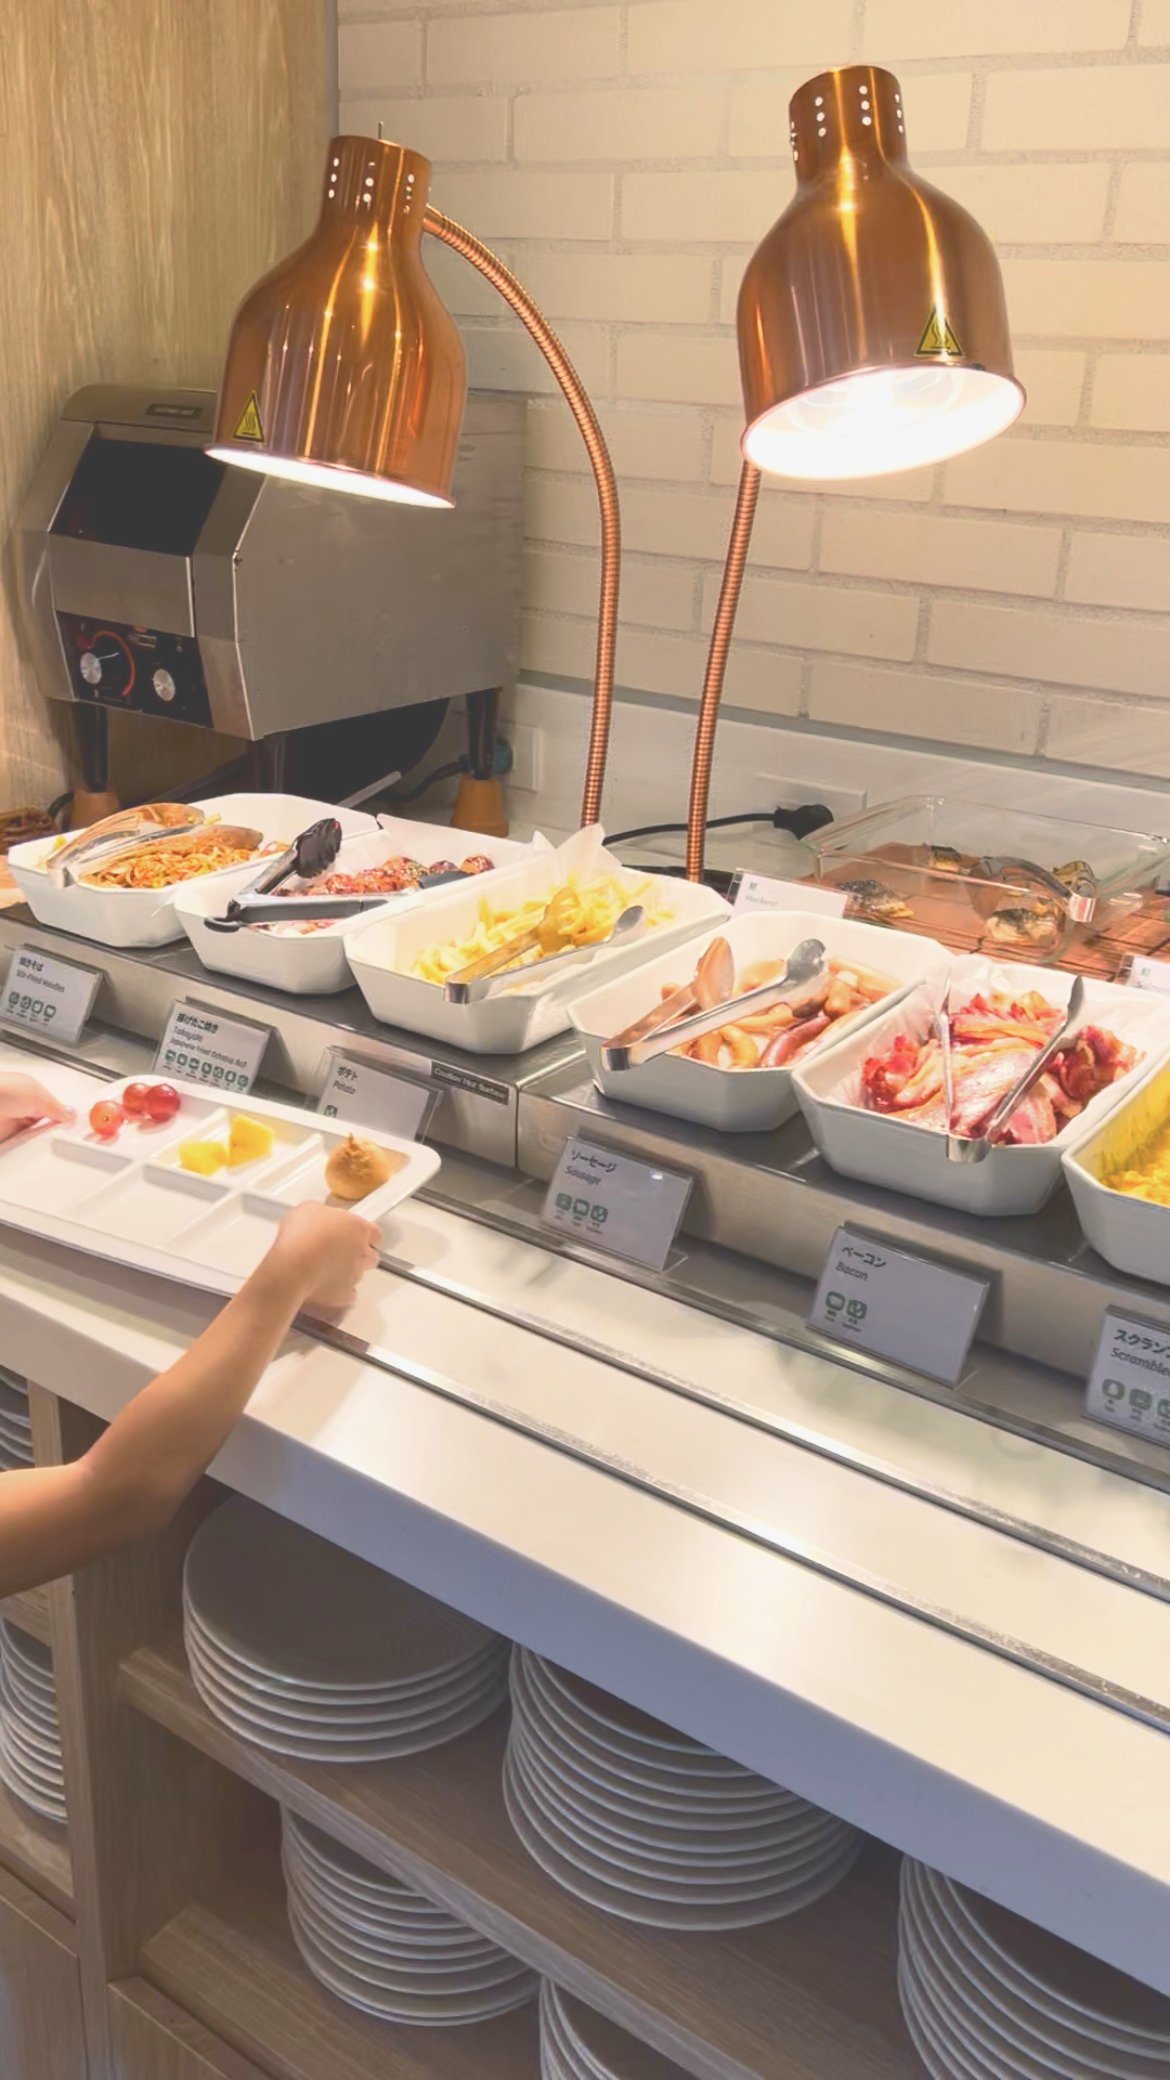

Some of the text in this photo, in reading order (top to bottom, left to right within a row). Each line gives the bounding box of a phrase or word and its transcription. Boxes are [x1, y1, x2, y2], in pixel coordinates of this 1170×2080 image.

[337, 1065, 358, 1080] ポテト
[333, 1080, 356, 1095] Potato
[572, 1150, 617, 1172] ソーセージ
[841, 1246, 887, 1268] ベーコン
[835, 1261, 869, 1281] Bacon
